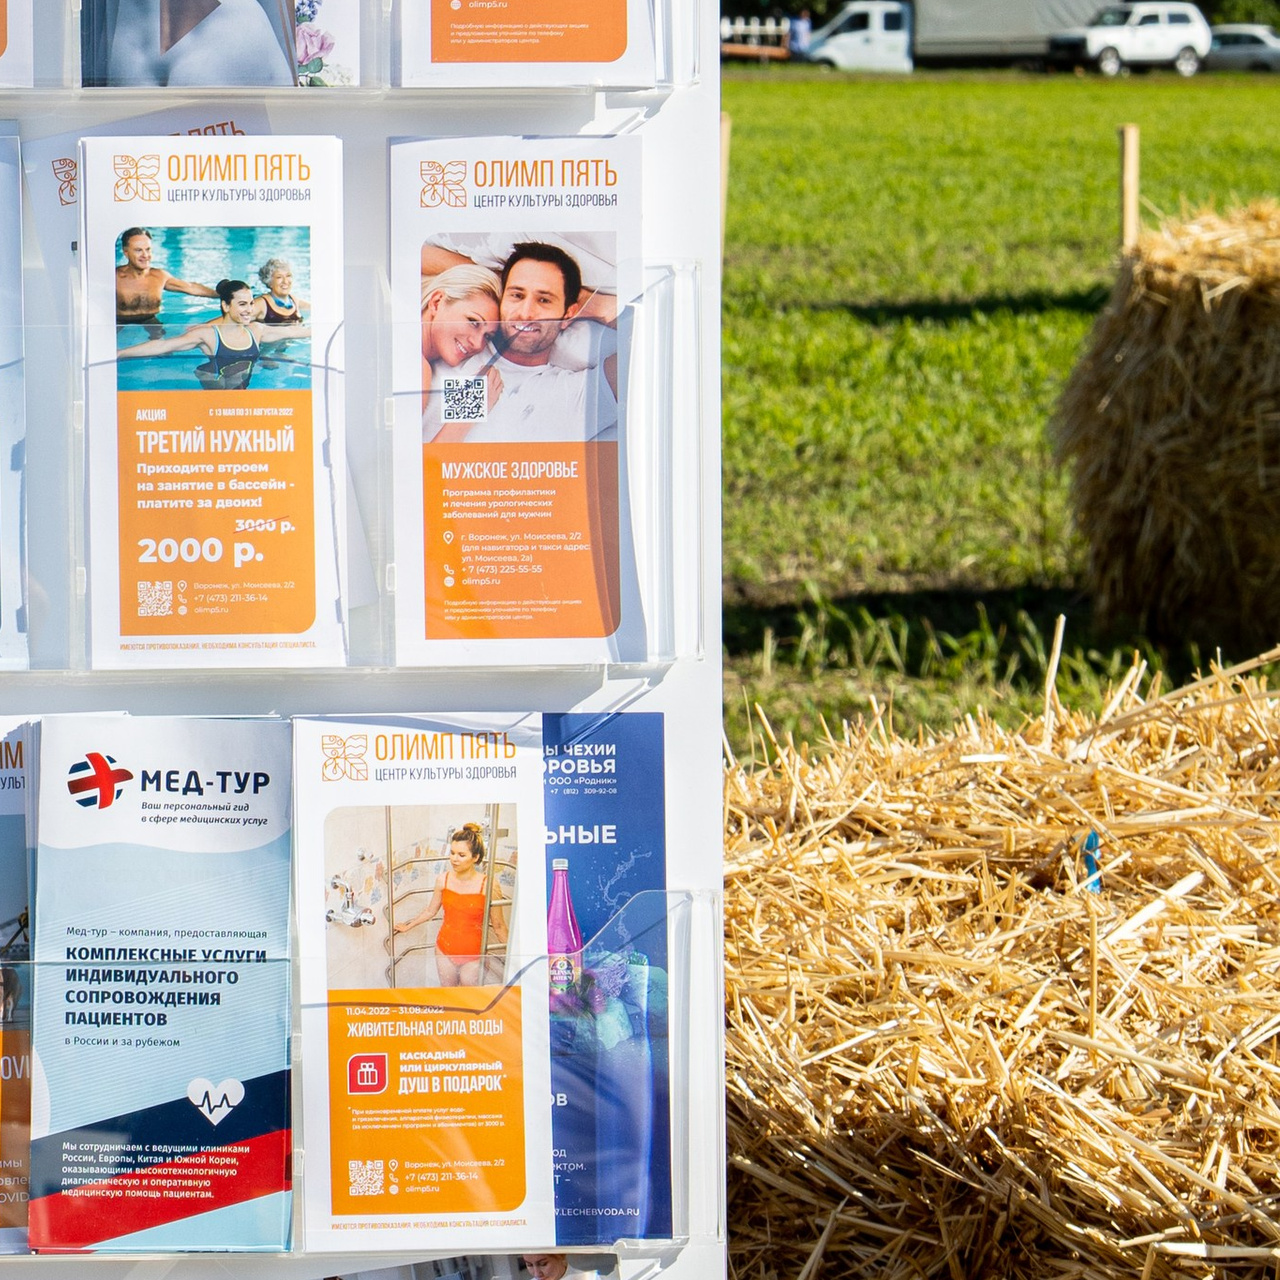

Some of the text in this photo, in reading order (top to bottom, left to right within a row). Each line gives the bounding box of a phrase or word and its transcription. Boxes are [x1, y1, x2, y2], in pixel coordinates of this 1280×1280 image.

[469, 0, 508, 8] olimp5.ru
[168, 154, 310, 181] ОЛИМП ПЯТЬ
[137, 425, 295, 453] ТРЕТИЙ НУЖНЫЙ
[137, 463, 268, 475] Приходите втроем
[442, 461, 578, 480] МУЖСКОЕ ЗДОРОВЬЕ
[137, 479, 286, 491] на занятие в бассейн
[137, 497, 262, 509] платите за двоих!
[137, 537, 264, 567] 2000 р.
[141, 770, 271, 795] МЕД-ТУР
[141, 802, 250, 813] Ваш персональный гид
[66, 969, 239, 984] ИНДИВИДУАЛЬНОГО
[66, 990, 221, 1007] СОПРОВОЖДЕНИЯ
[65, 1012, 167, 1029] ПАЦИЕНТОВ
[347, 1019, 503, 1037] ЖИВИТЕЛЬНАЯ СИЛА ВОДЫ
[74, 1037, 109, 1045] России
[135, 1037, 180, 1048] рубежом
[400, 1048, 465, 1060] КАСКАДНЫЙ
[400, 1060, 502, 1073] ИЛИ ЦИРКУЛЯРНЫЙ
[399, 1077, 429, 1095] ДУШ
[432, 1077, 440, 1092] В
